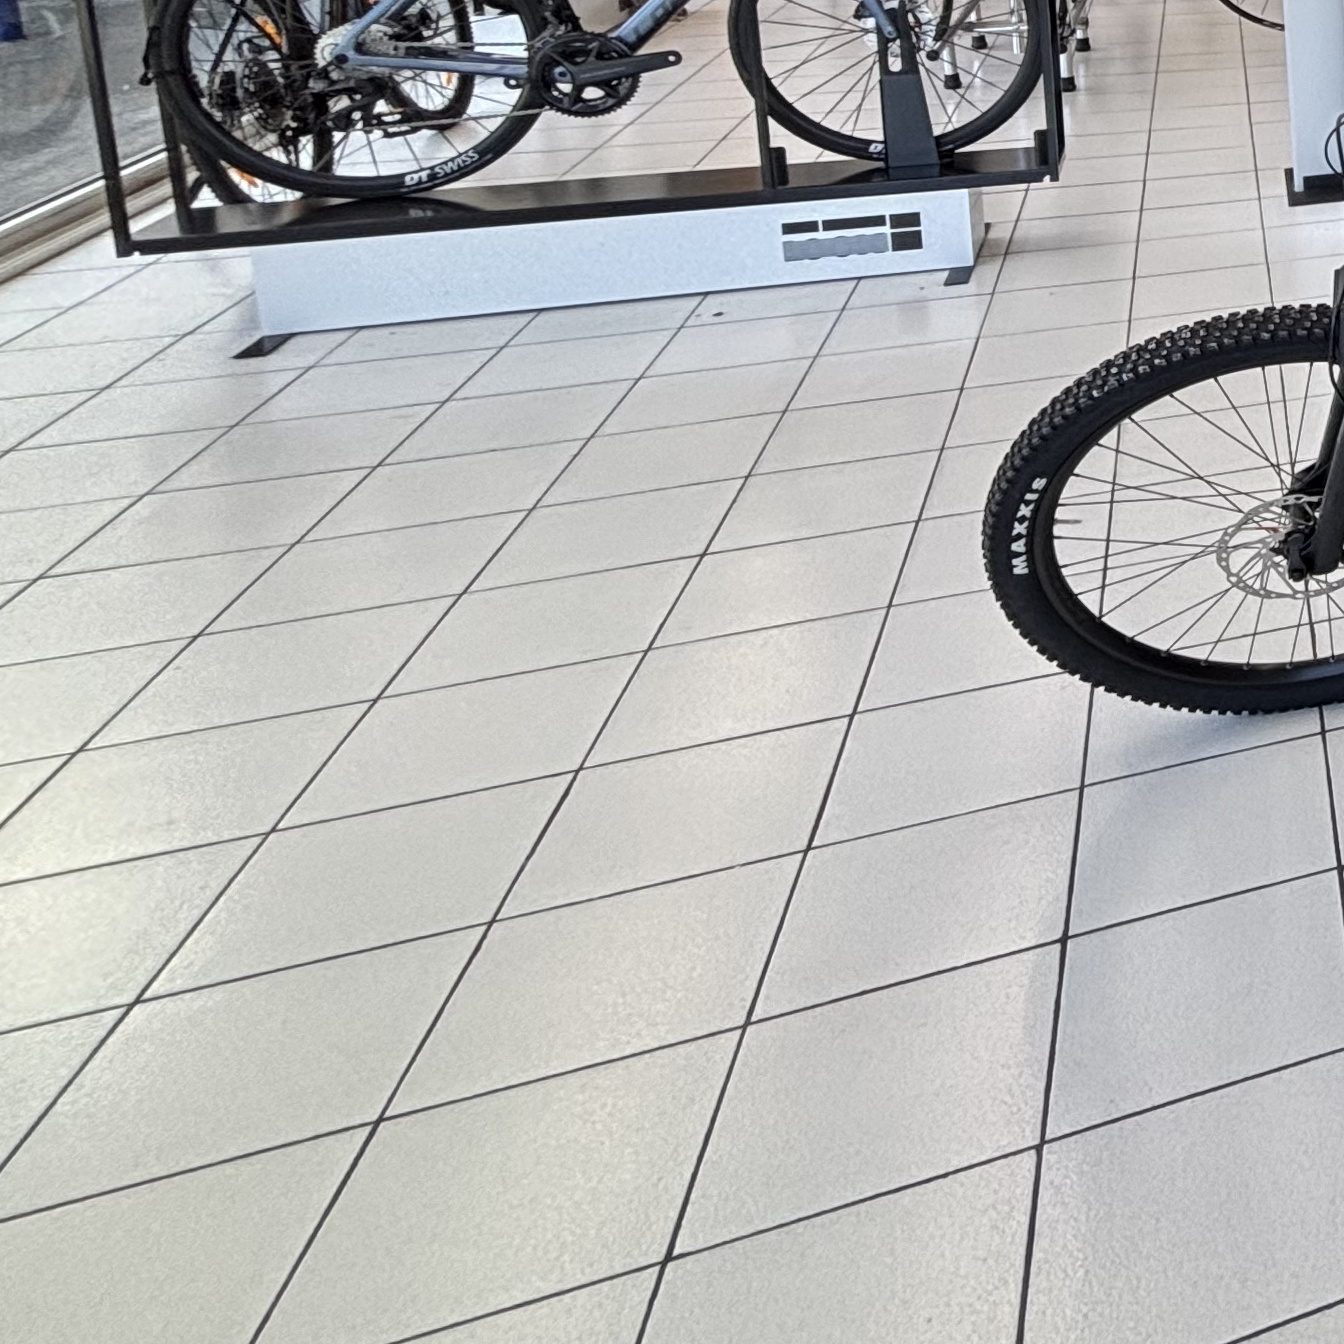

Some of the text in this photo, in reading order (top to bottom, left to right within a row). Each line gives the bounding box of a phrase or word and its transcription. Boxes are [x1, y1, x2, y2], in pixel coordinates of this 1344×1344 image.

[403, 149, 480, 185] DT SWISS
[1011, 475, 1049, 576] MAXXIS
